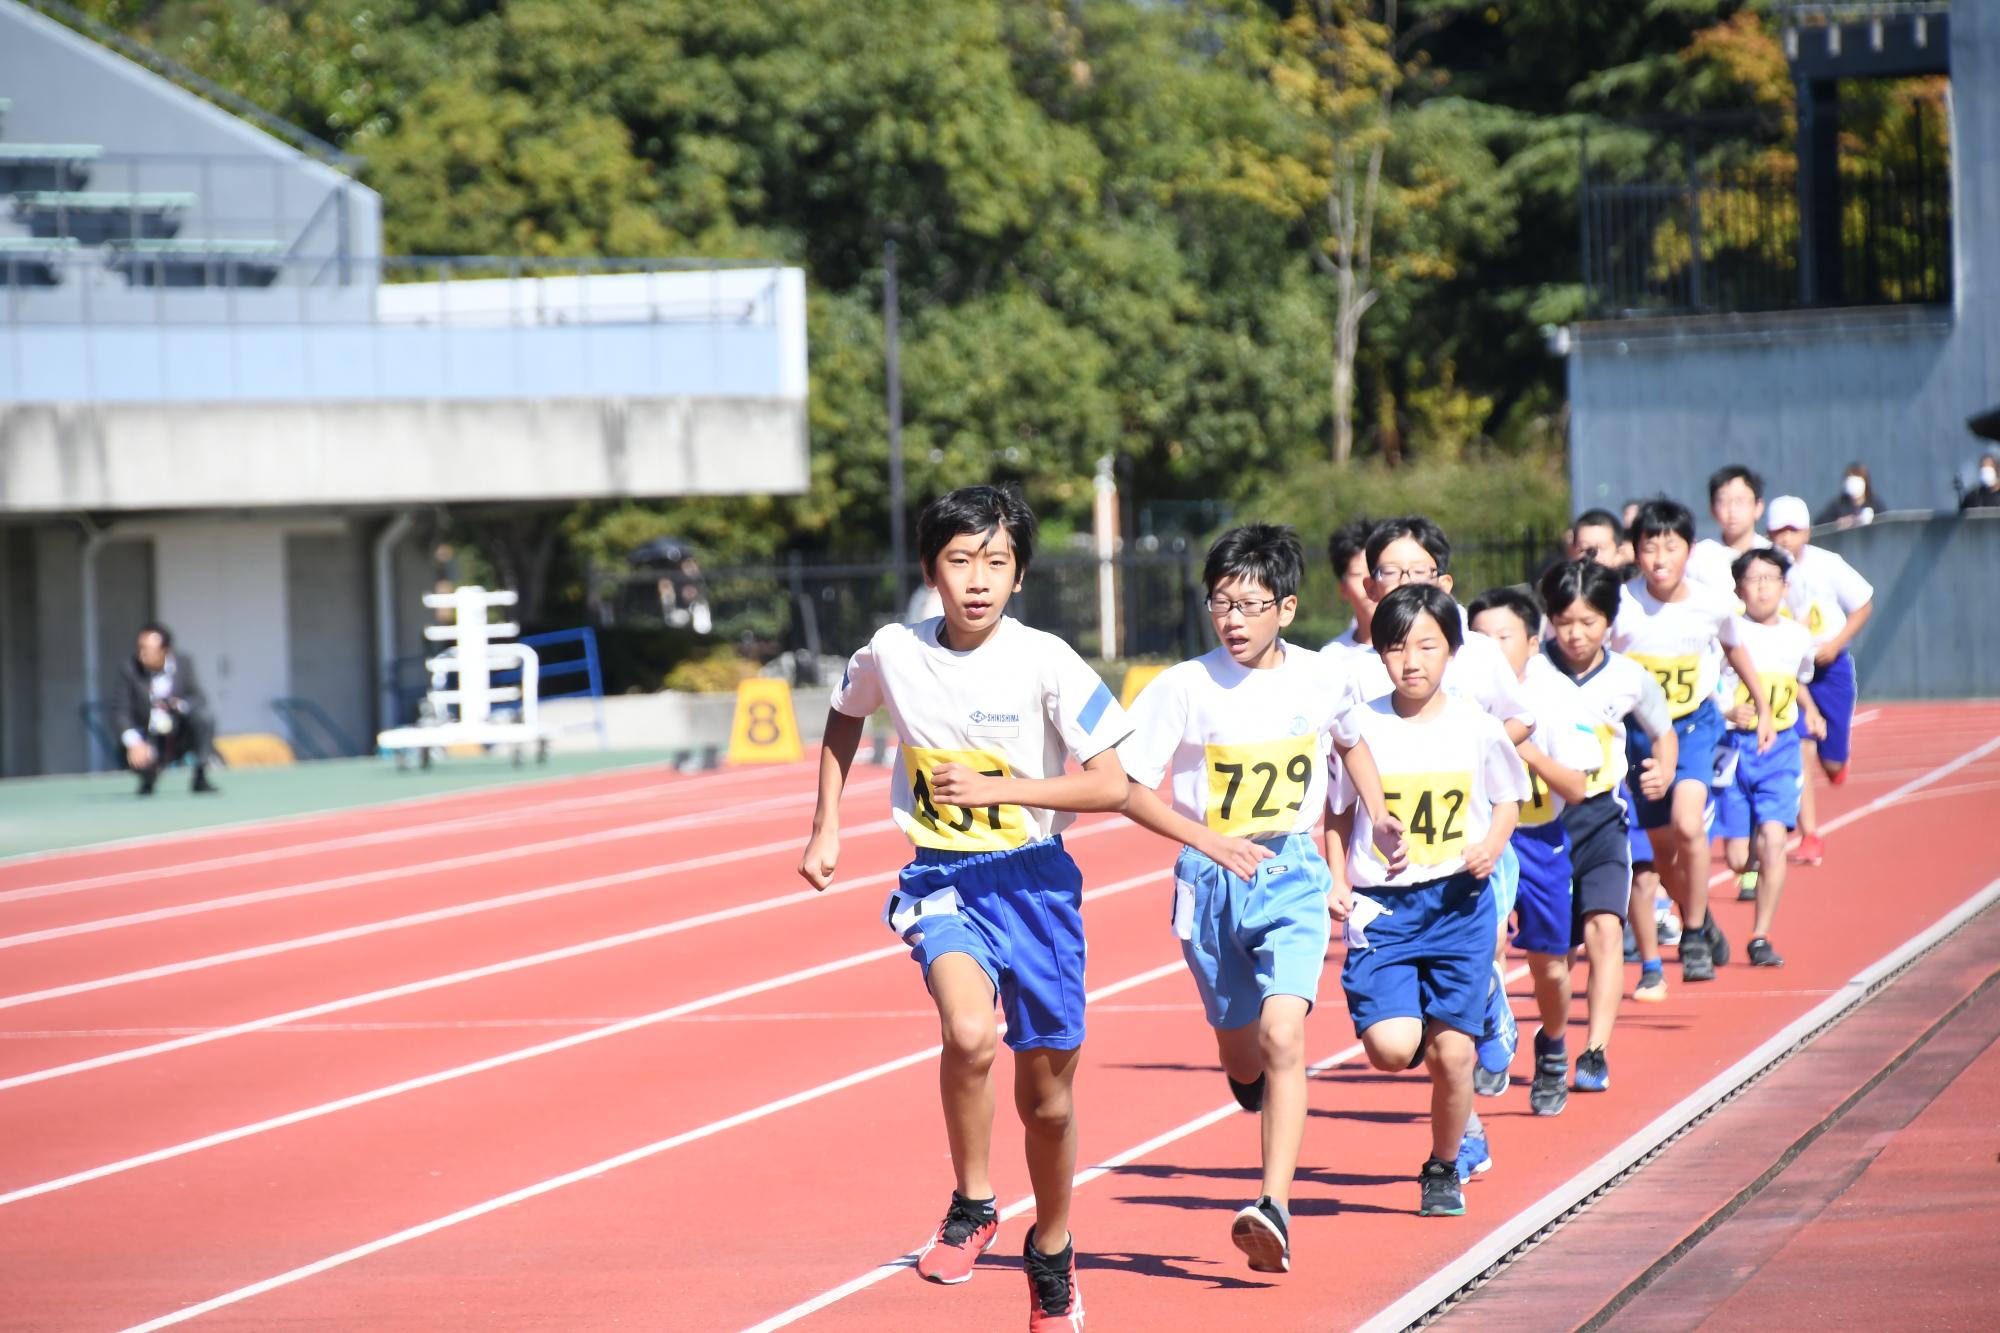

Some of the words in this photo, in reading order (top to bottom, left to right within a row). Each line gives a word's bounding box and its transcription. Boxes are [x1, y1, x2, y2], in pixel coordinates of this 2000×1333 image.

[1643, 665, 1696, 704] 35
[748, 701, 779, 745] 8
[1214, 754, 1312, 820] 729
